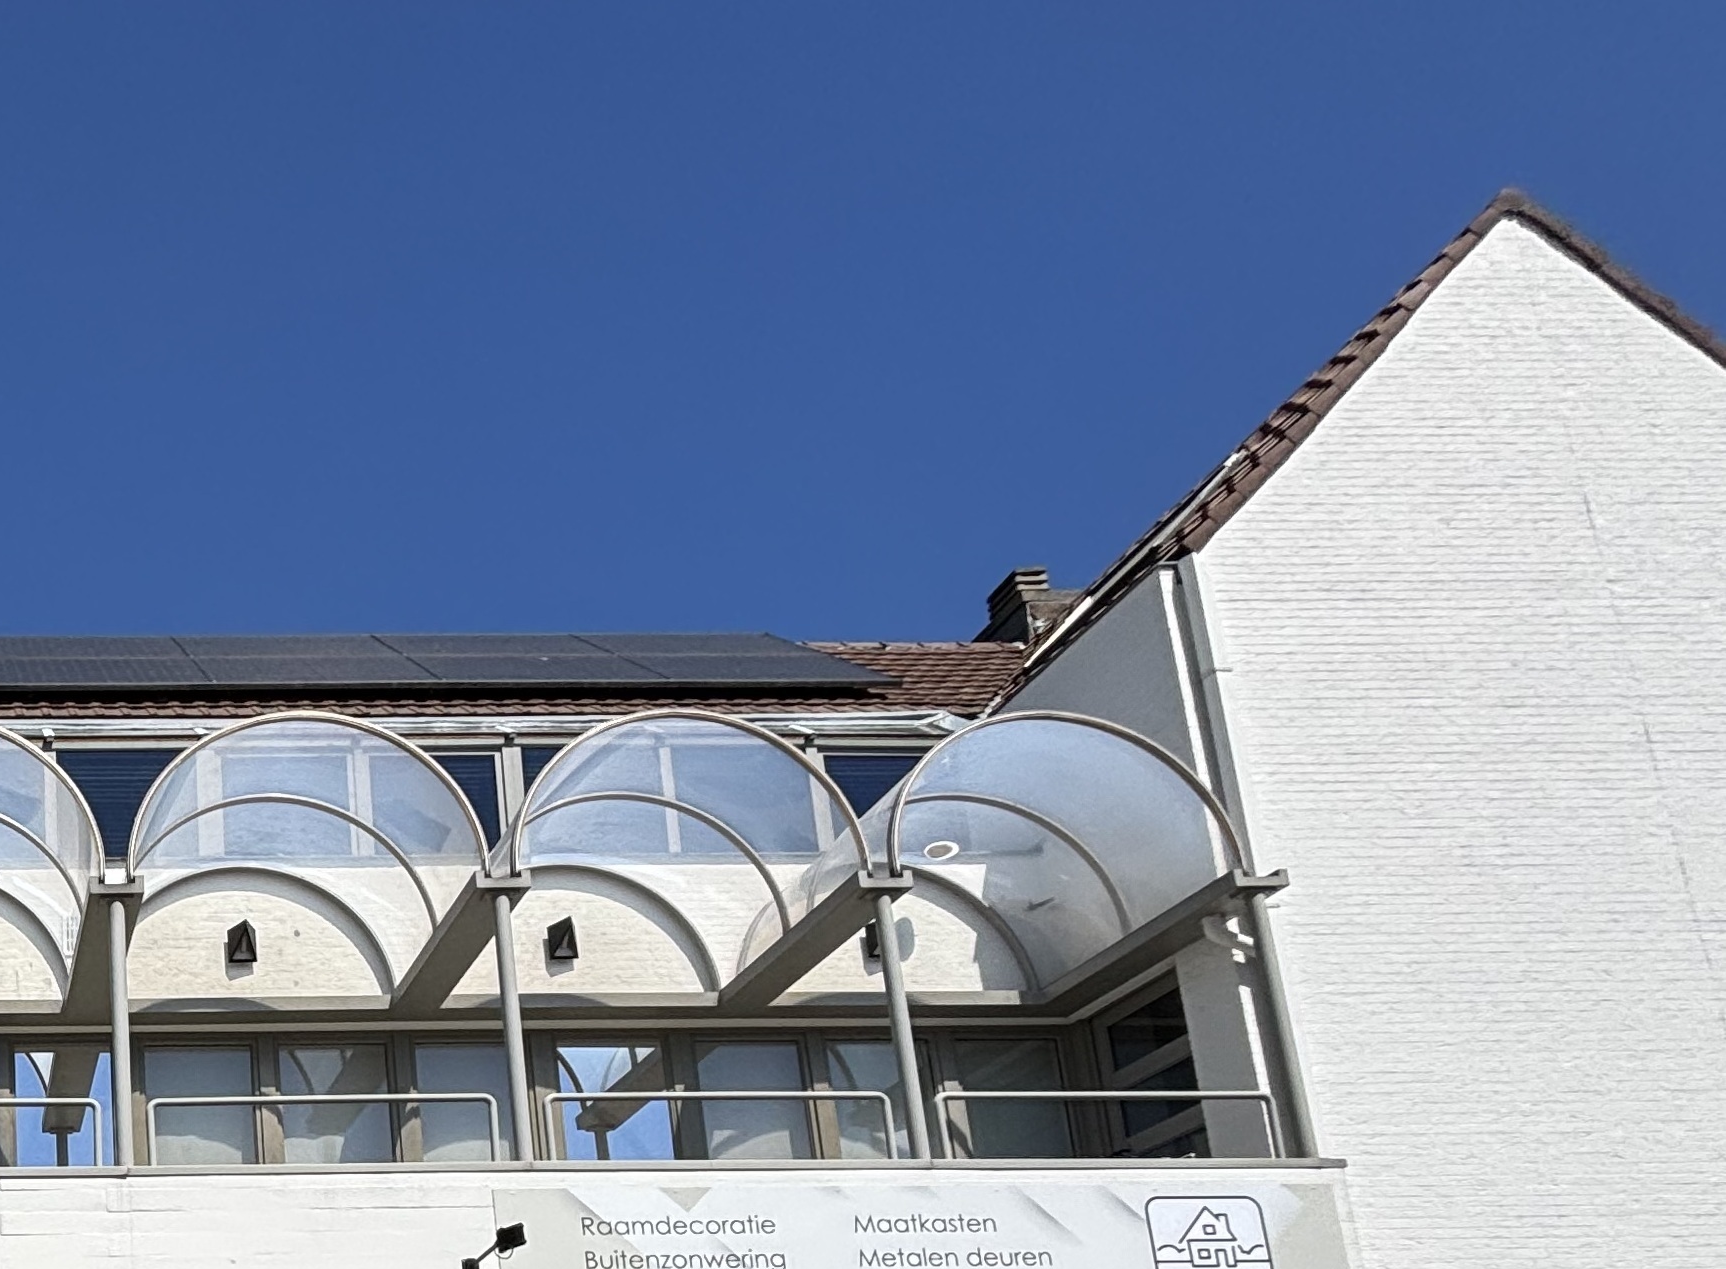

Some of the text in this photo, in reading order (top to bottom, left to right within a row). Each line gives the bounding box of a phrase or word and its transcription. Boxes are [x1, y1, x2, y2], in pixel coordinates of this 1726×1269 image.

[581, 1215, 776, 1236] Raamdecoratie
[854, 1214, 997, 1233] Maatkasten
[859, 1247, 1053, 1267] Metalen deuren
